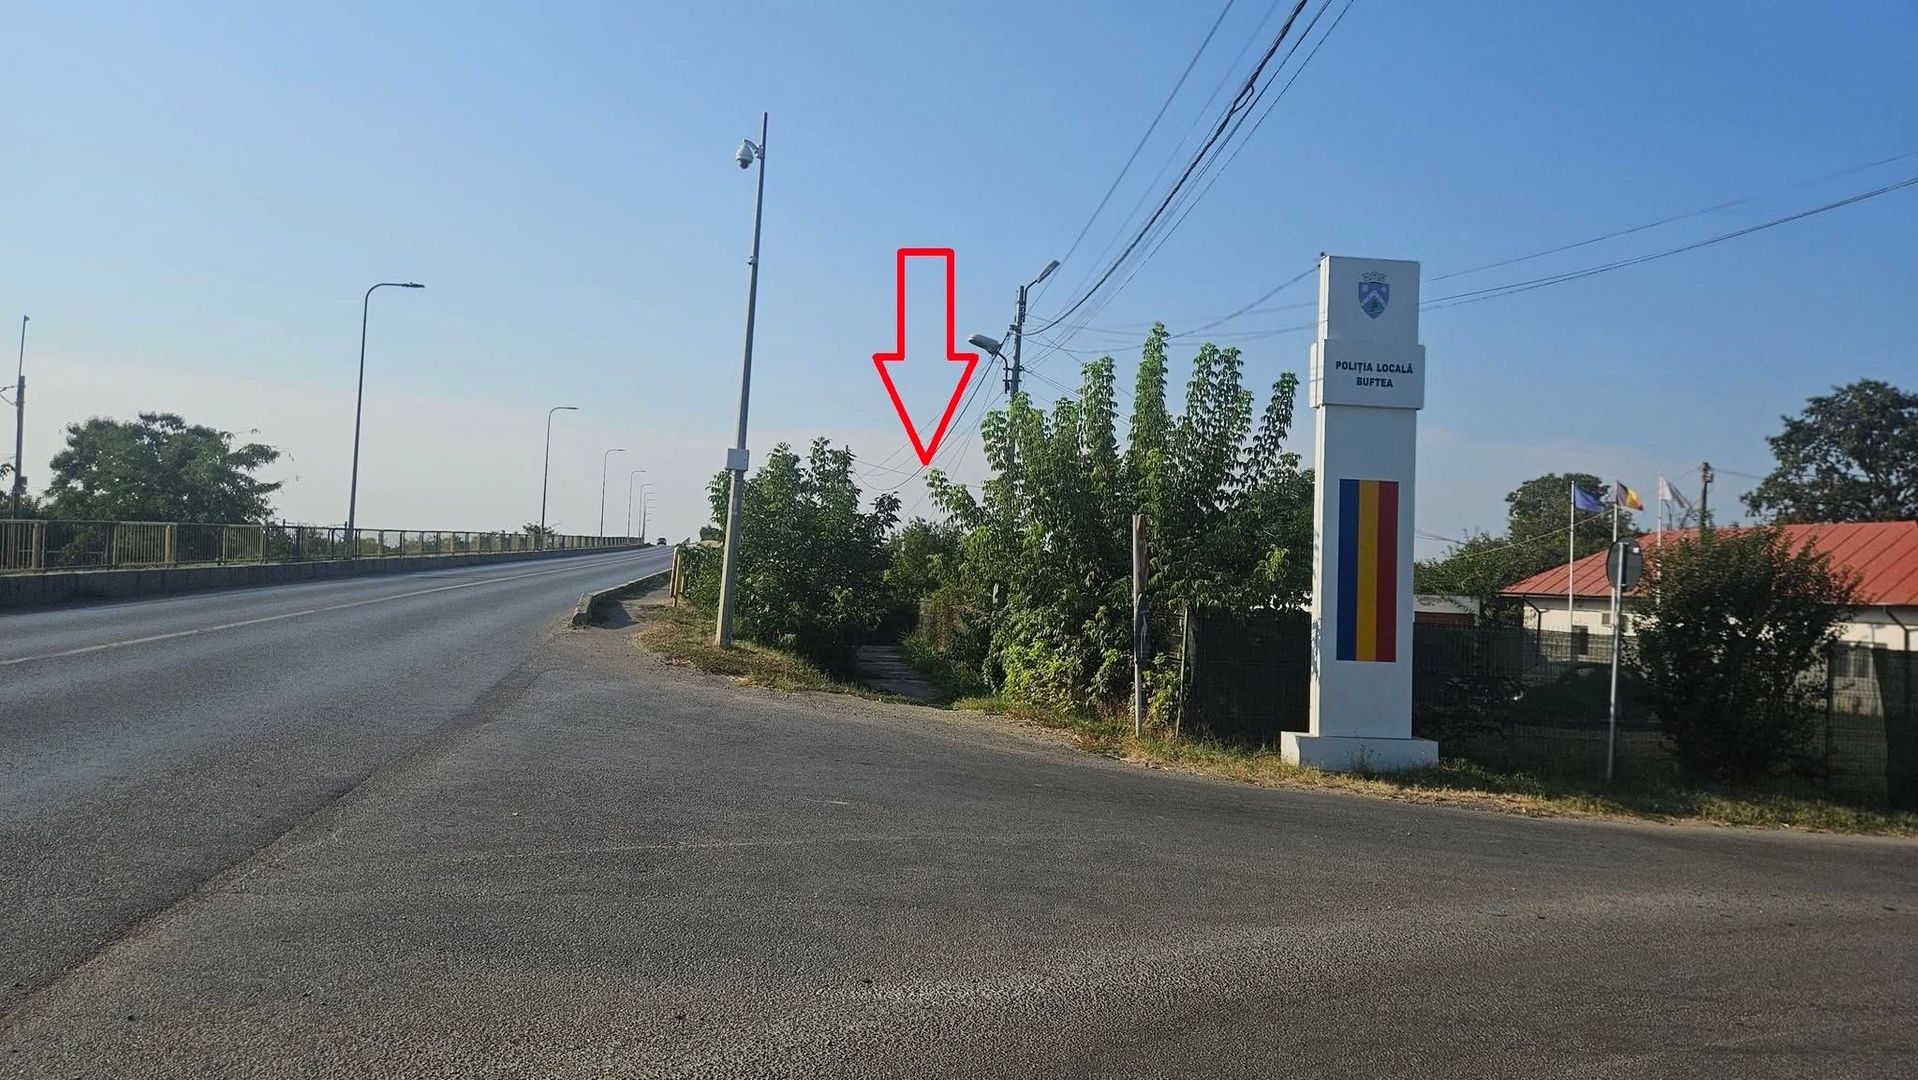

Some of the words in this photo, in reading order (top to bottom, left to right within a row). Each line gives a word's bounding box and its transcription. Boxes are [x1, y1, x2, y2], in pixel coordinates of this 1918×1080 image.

[1336, 361, 1373, 374] POLIȚIA
[1376, 363, 1413, 374] LOCALĂ
[1356, 377, 1393, 388] BUFTEA
